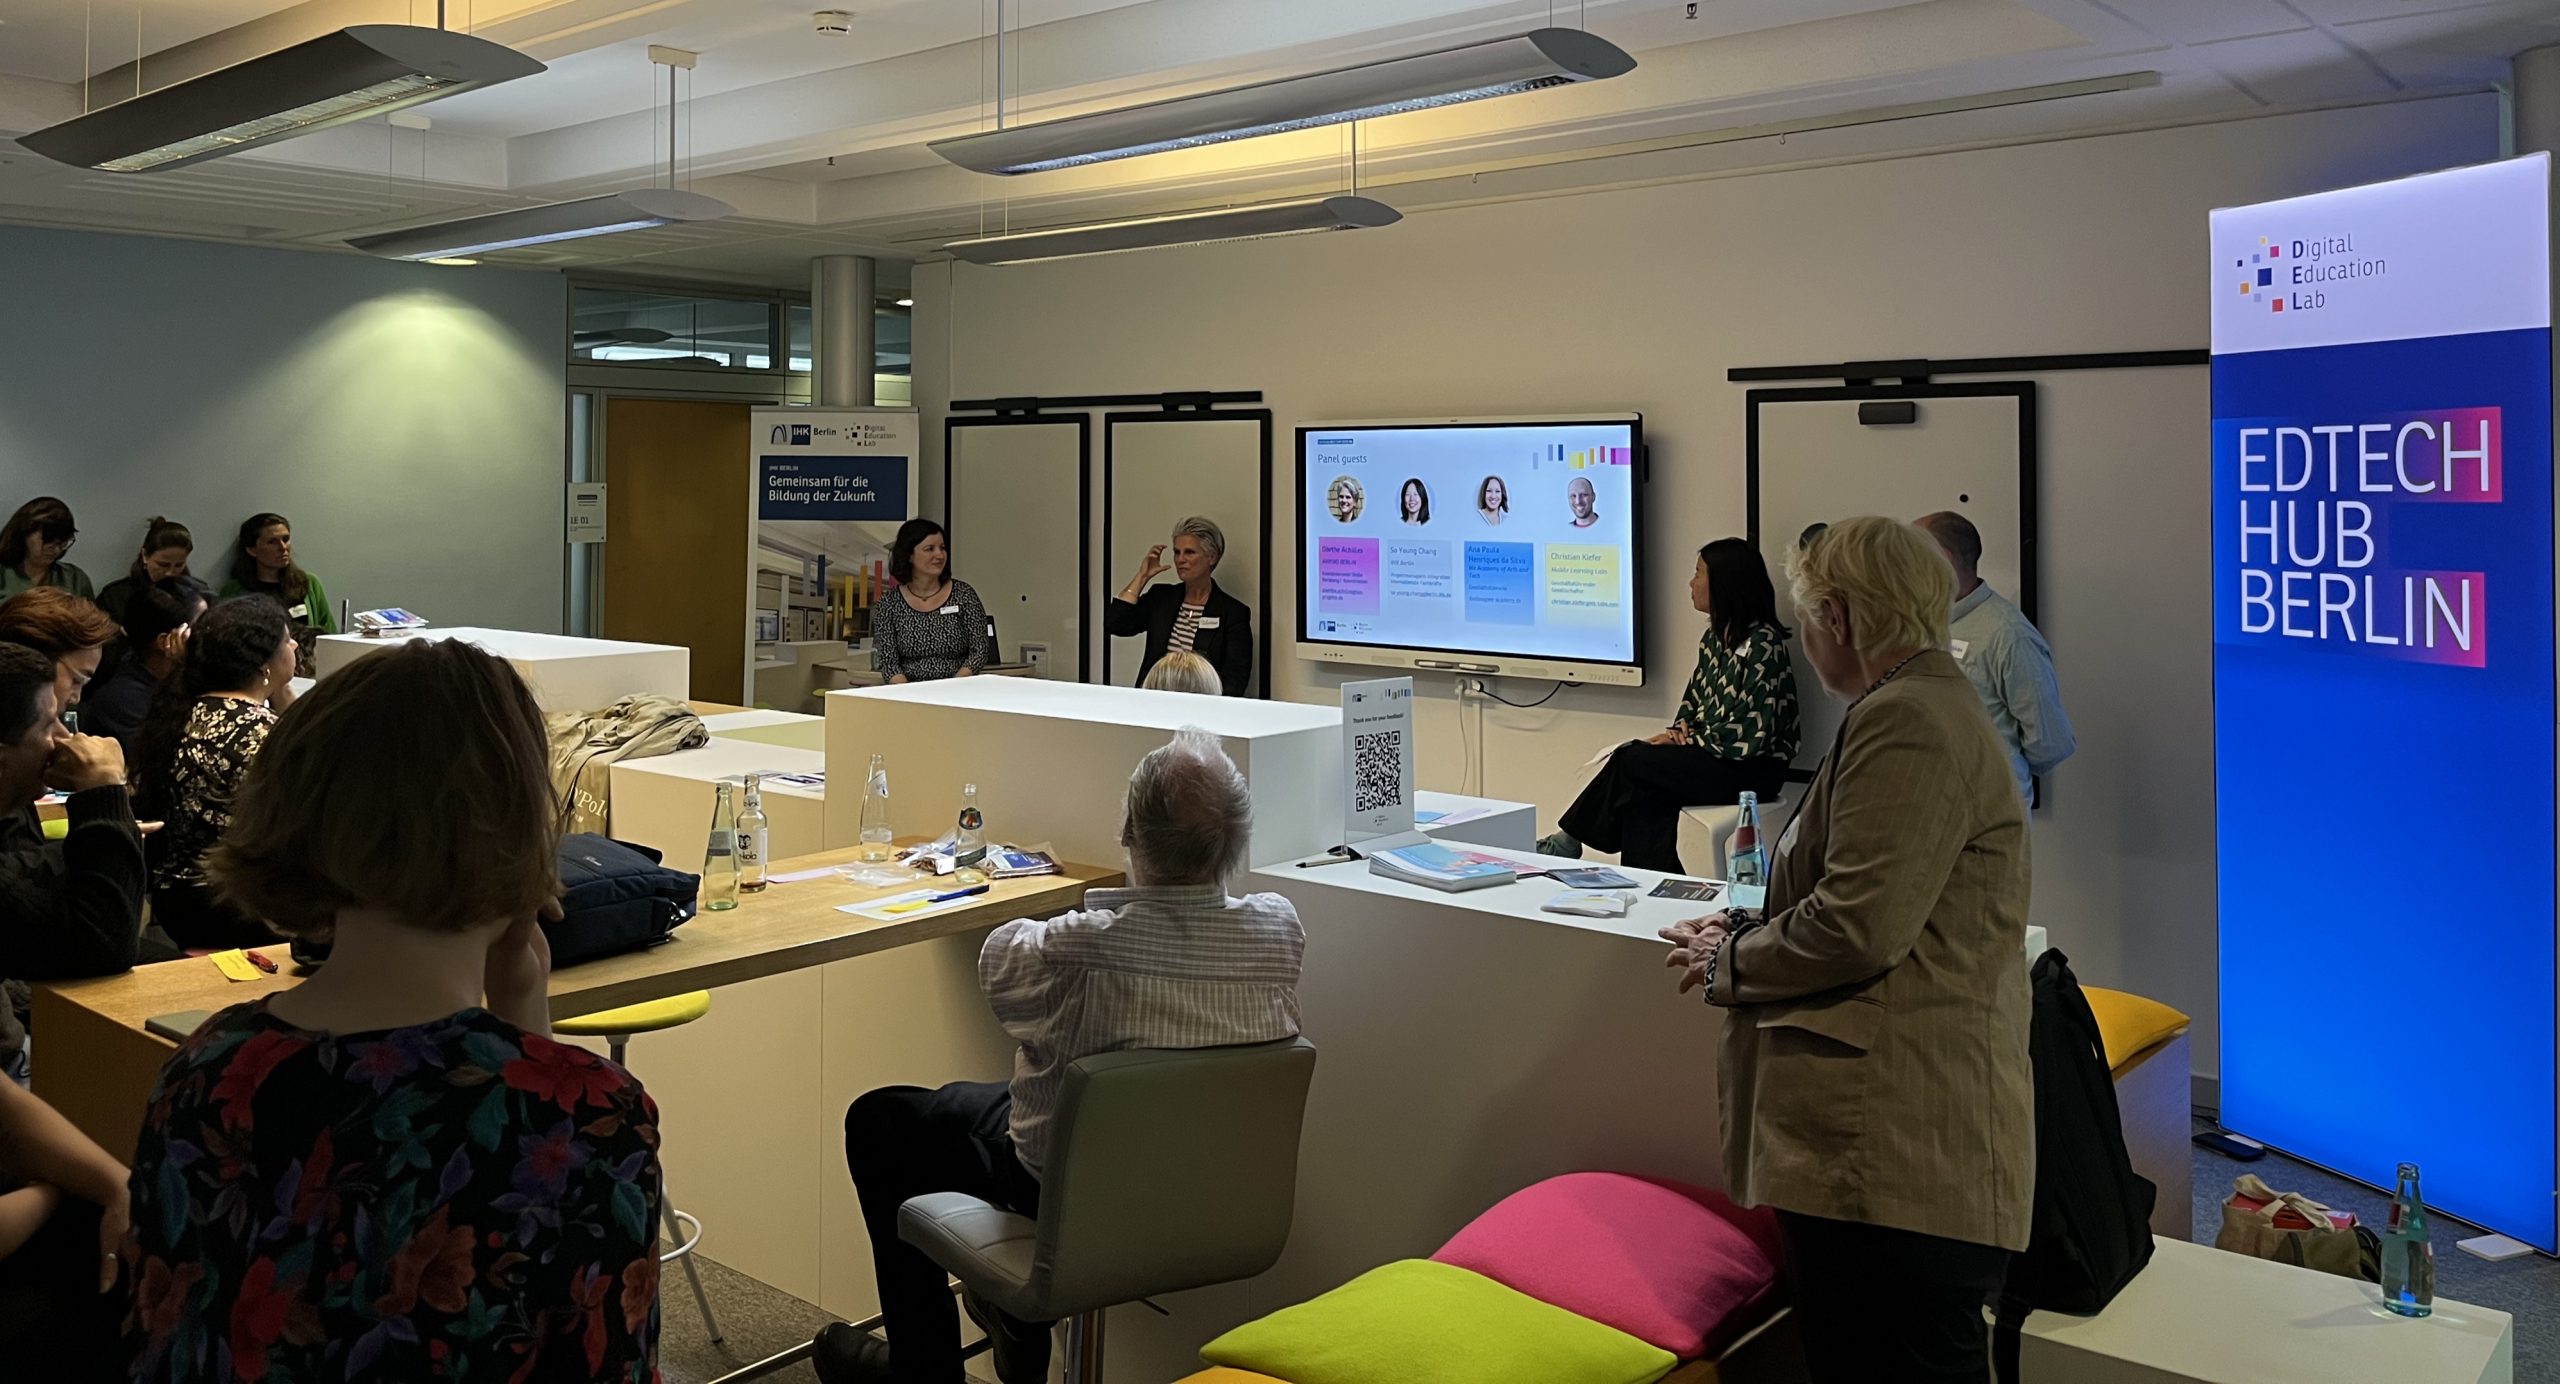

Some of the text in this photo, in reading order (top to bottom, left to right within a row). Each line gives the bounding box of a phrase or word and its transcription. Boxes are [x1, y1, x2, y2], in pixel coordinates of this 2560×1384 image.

[2292, 233, 2353, 261] Digital
[2292, 258, 2386, 285] Education
[2292, 289, 2325, 310] Lab
[793, 427, 837, 436] IHK Berlin
[864, 424, 886, 433] Digital
[1317, 454, 1368, 466] Panel guests
[2239, 418, 2490, 495] EDTECH
[768, 475, 869, 487] Gemeinsam für die
[768, 490, 876, 504] Bildung der Zukunft
[2240, 499, 2375, 568] HUB
[2240, 568, 2471, 652] BERLIN
